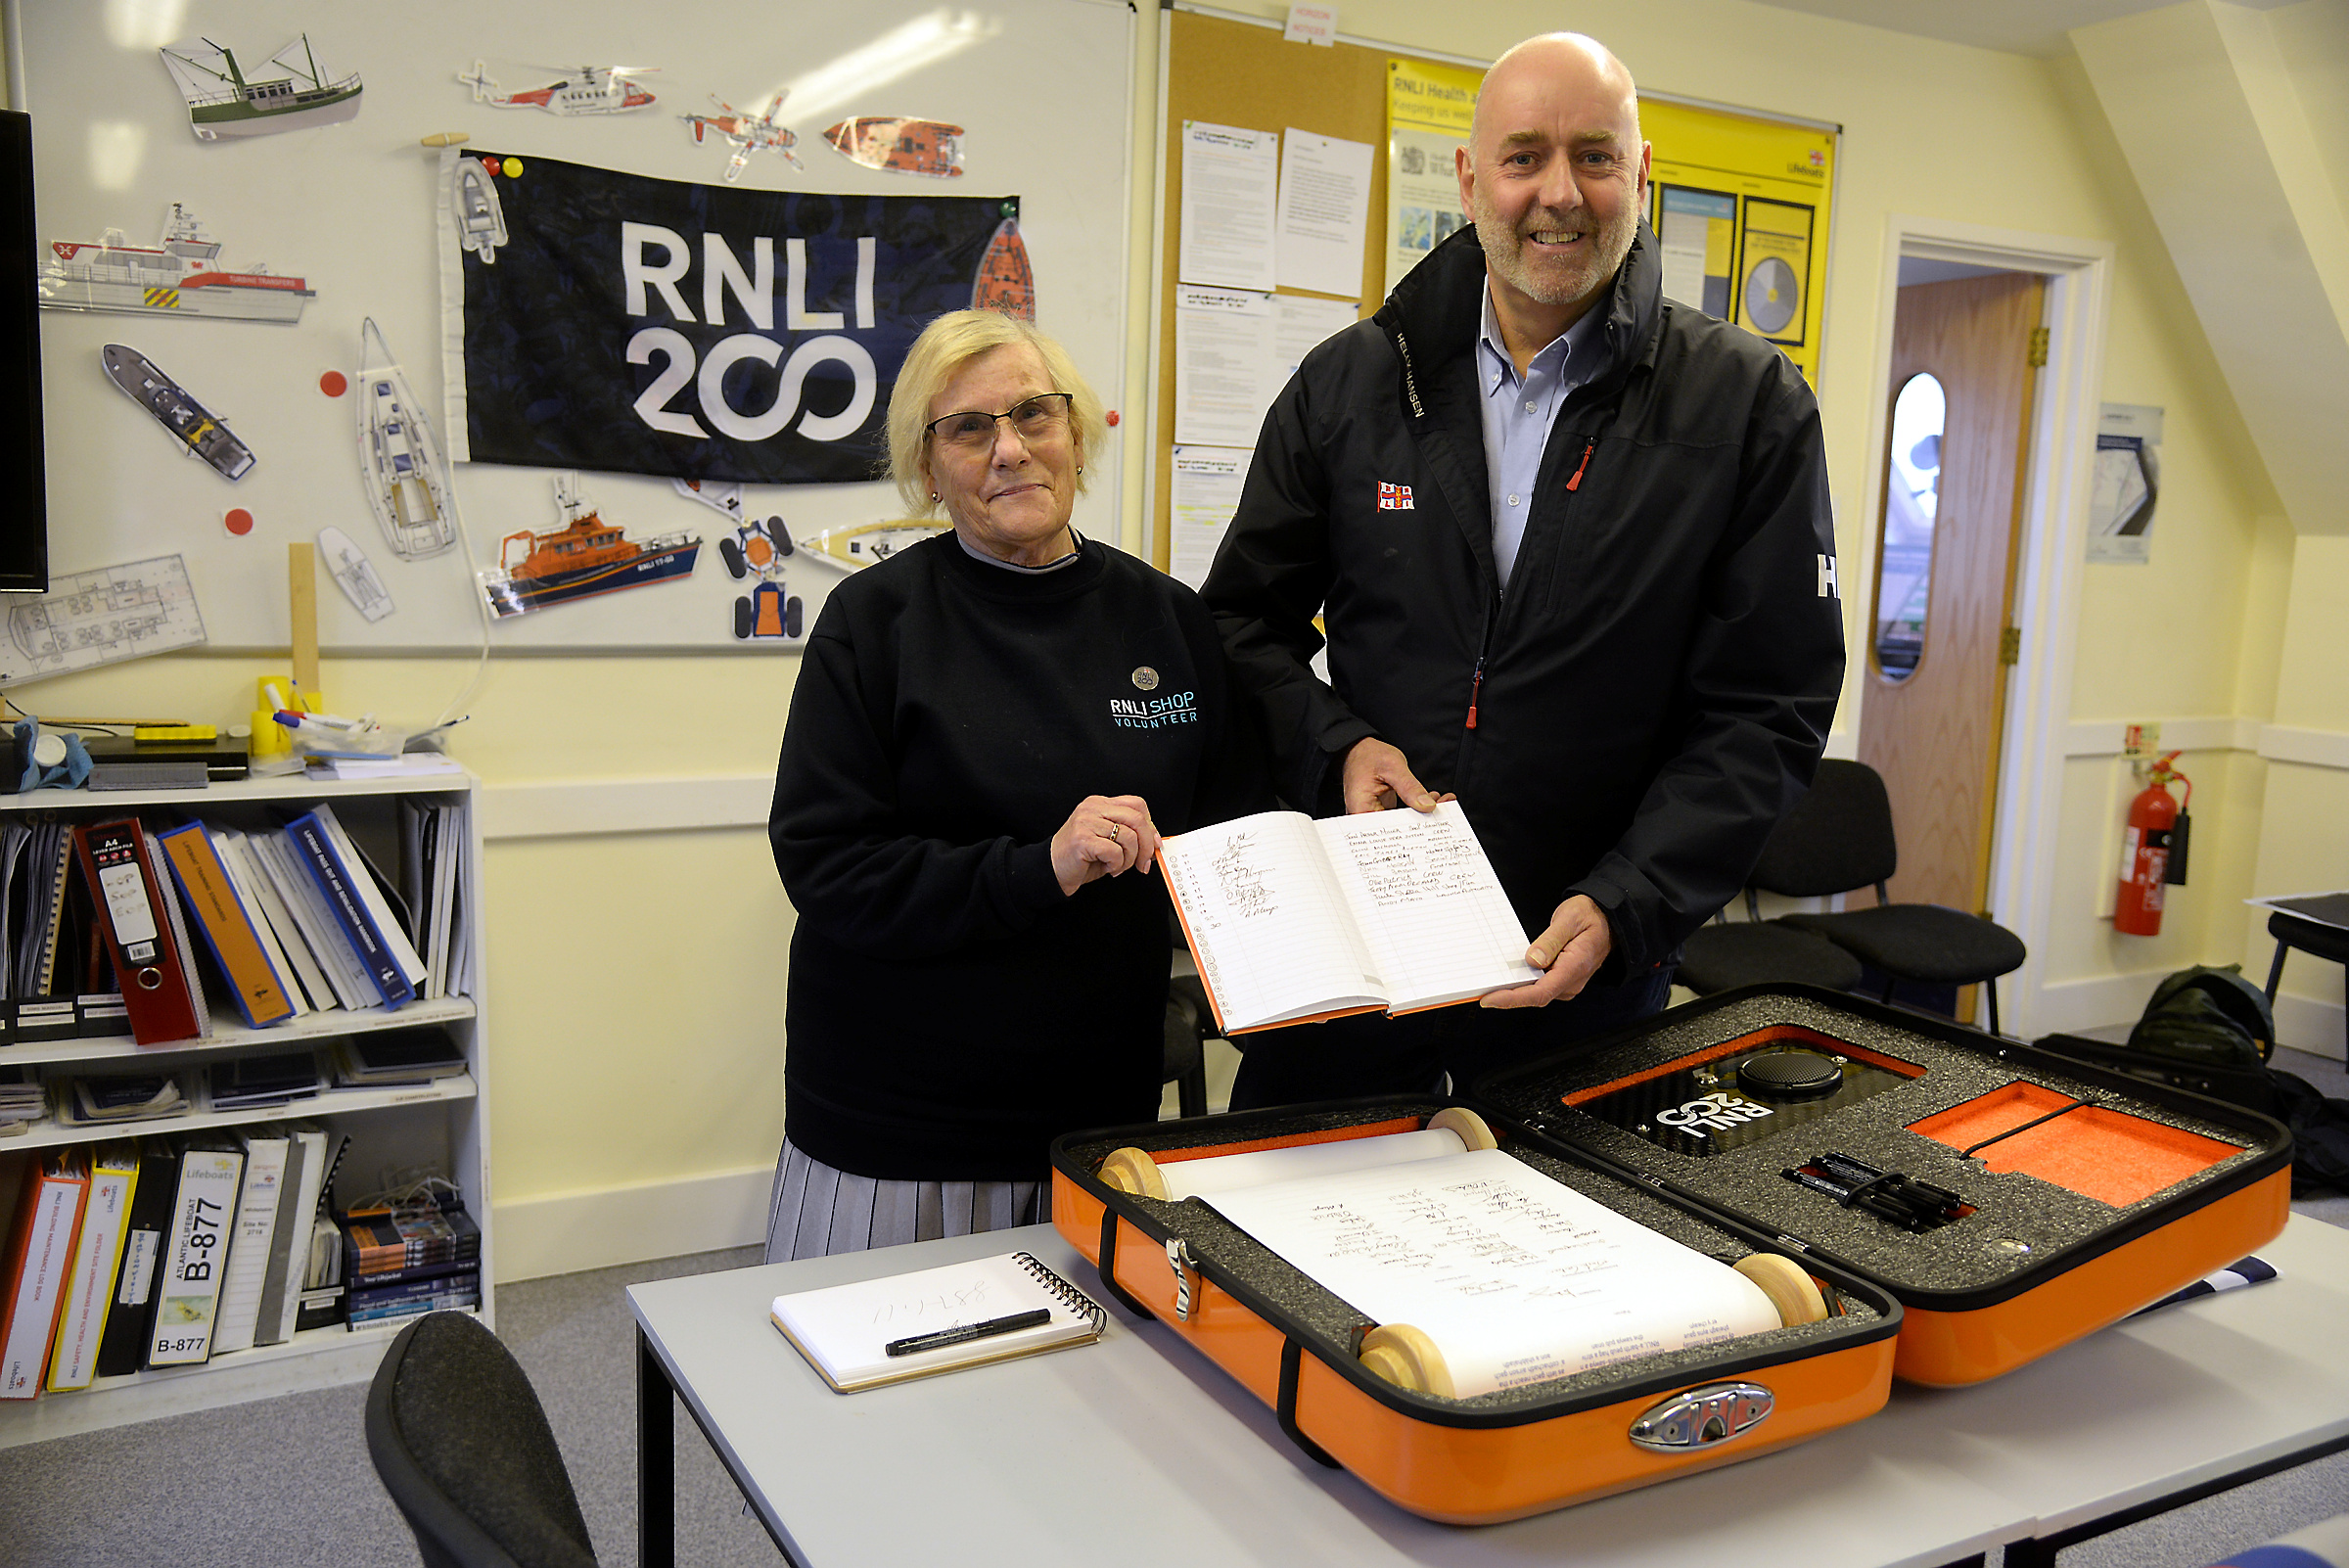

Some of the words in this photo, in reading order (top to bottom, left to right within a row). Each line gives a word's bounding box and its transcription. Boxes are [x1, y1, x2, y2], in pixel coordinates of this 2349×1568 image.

[1394, 76, 1423, 95] RNLI
[1427, 84, 1467, 103] Health
[1393, 99, 1434, 117] Keeping
[229, 274, 257, 285] TURBINE
[258, 276, 296, 287] TRANSFERS
[622, 220, 877, 330] RNLI
[625, 326, 877, 441] 200
[1406, 370, 1425, 418] HANSEN
[1818, 553, 1840, 599] H
[1137, 671, 1155, 680] RNLI
[1110, 699, 1147, 715] RNLI
[1149, 691, 1194, 714] SHOP
[1114, 712, 1198, 728] VOLUNTEER
[302, 828, 322, 855] LIFEBOAT
[316, 853, 329, 868] PASS
[324, 866, 336, 880] OUT
[330, 877, 343, 892] AND
[182, 840, 199, 865] LIFEBOAT
[195, 865, 211, 892] TRAINING
[207, 891, 227, 922] STANDARDS
[1656, 1092, 1743, 1126] 200
[1678, 1101, 1774, 1138] RNLI
[186, 1170, 234, 1180] Lifeboats
[107, 1184, 118, 1213] Lifeboats
[48, 1205, 60, 1232] BUILDING
[39, 1232, 54, 1272] MAINTENANCE
[94, 1232, 104, 1254] FOLDER
[176, 1238, 190, 1279] ATLANTIC
[186, 1198, 197, 1237] LIFEBOAT
[183, 1197, 222, 1281] B-877
[91, 1254, 100, 1268] SITE
[36, 1273, 45, 1284] LOG
[83, 1268, 97, 1308] ENVIRONMENT
[33, 1284, 43, 1302] BOOK
[81, 1308, 90, 1319] AND
[77, 1320, 87, 1342] HEALTH
[157, 1337, 206, 1353] B-877
[8, 1360, 22, 1390] Lifeboats
[70, 1364, 79, 1378] RNLI
